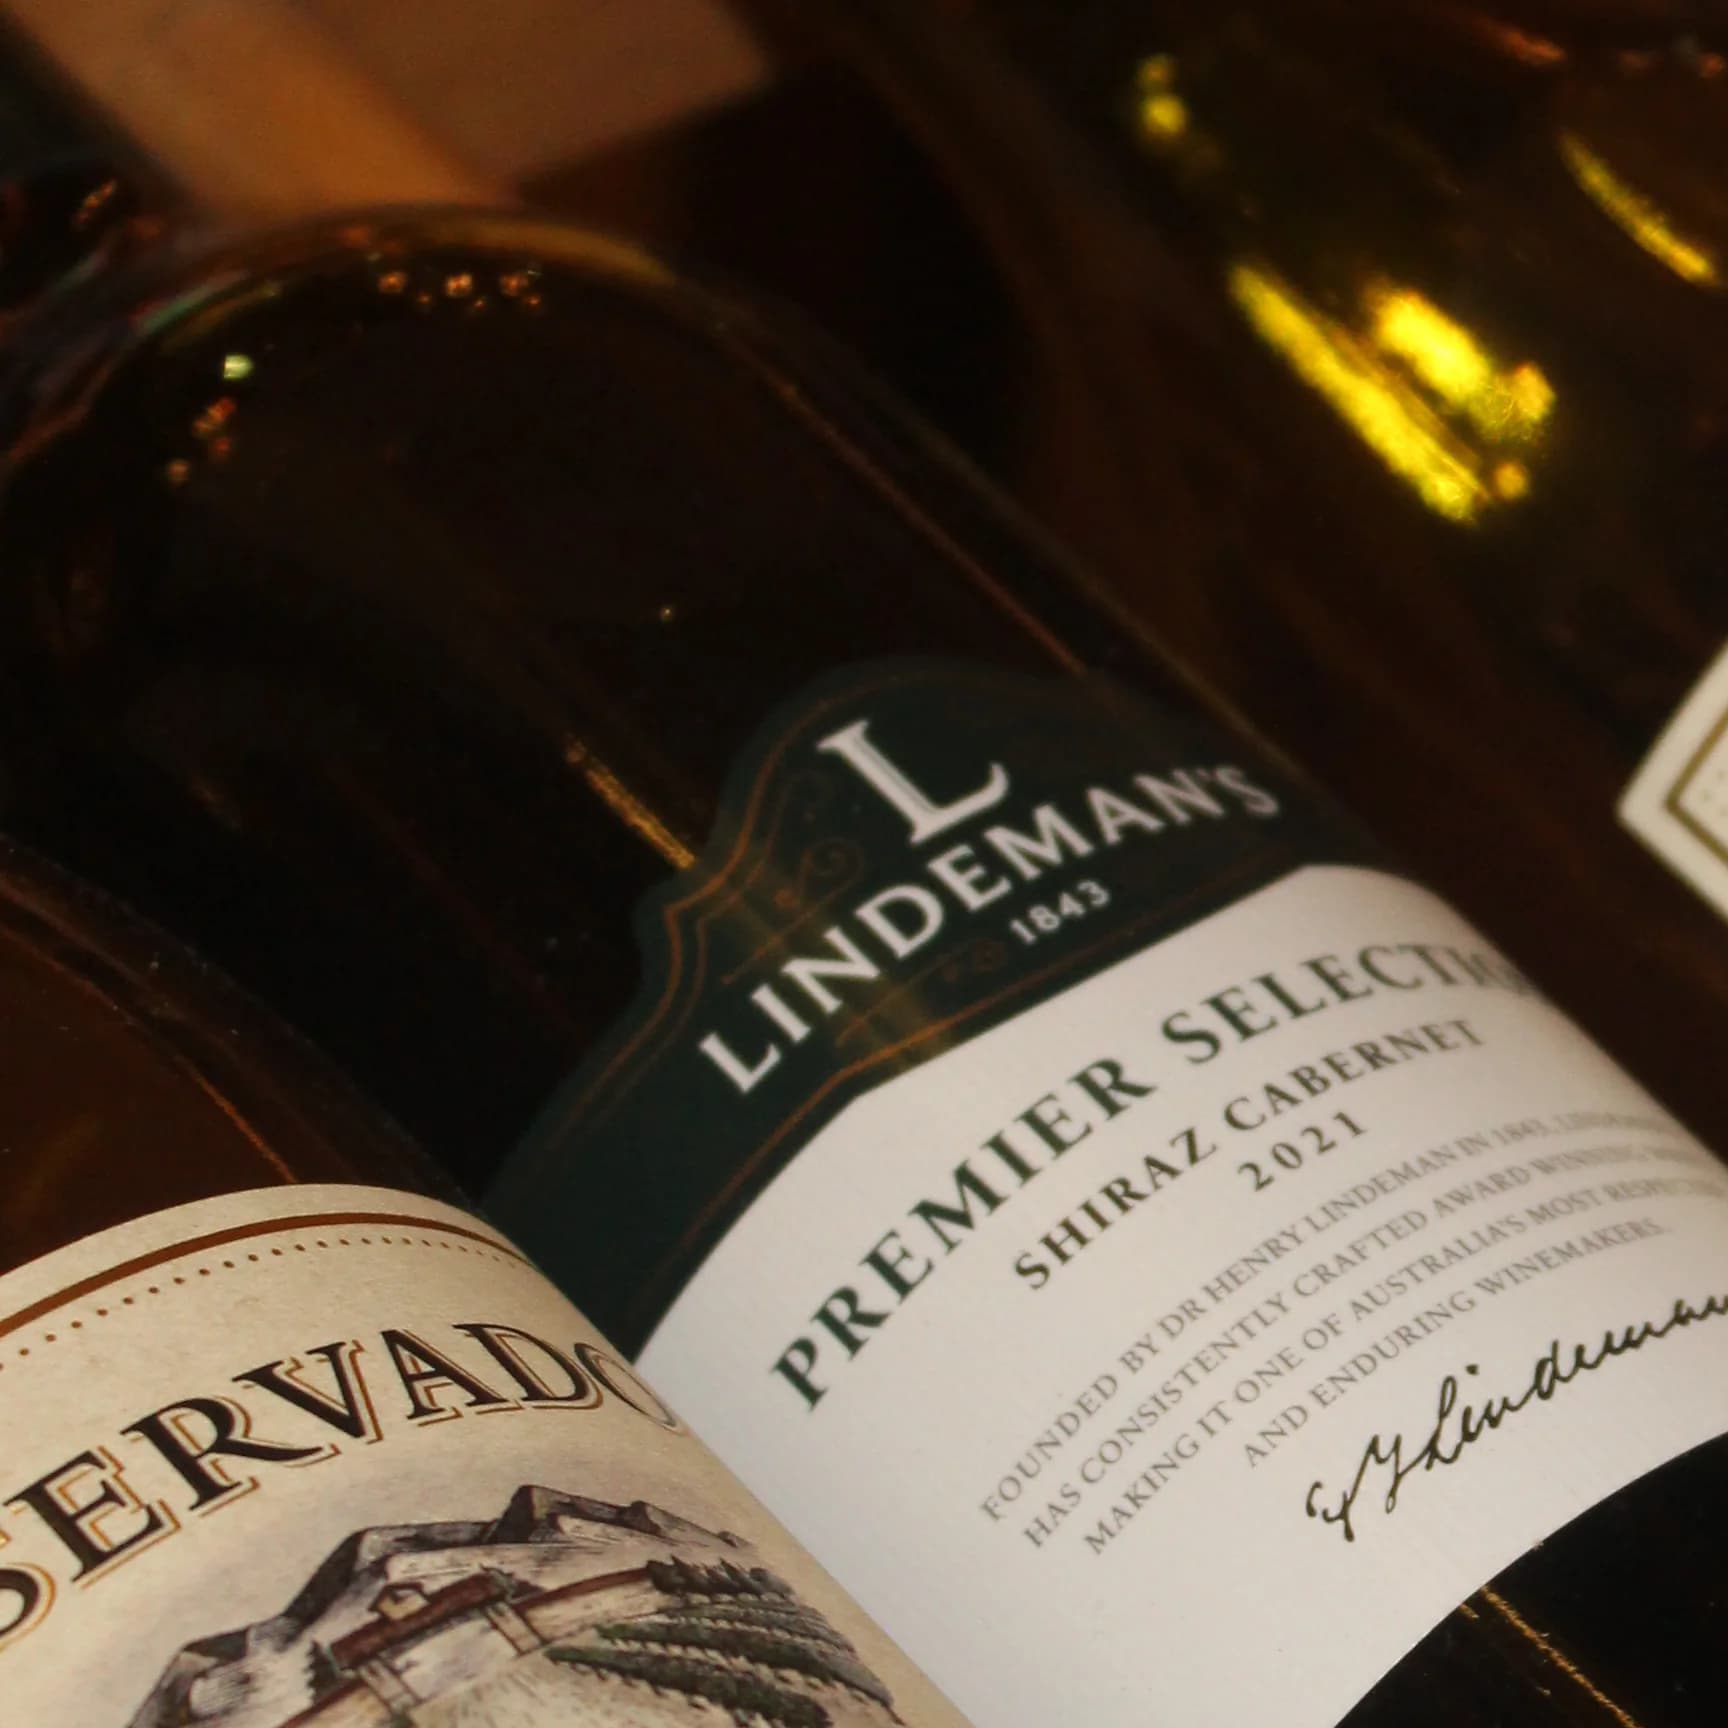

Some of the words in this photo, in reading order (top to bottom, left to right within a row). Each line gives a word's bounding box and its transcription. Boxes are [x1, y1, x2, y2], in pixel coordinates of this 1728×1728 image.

[816, 719, 1009, 845] L
[1009, 879, 1111, 946] 1843
[767, 1057, 1159, 1413] PREMIER
[1160, 942, 1538, 1065] SELECTI
[1013, 1126, 1219, 1291] SHIRAZ
[1223, 1019, 1486, 1133] CABERNET
[1237, 1110, 1368, 1193] 2021
[979, 1372, 1120, 1523] FOUNDED
[1117, 1332, 1161, 1374] BY
[1157, 1296, 1209, 1341] DR
[1201, 1223, 1305, 1305] HENRY
[1303, 1144, 1457, 1233] LINDEMAN
[1453, 1131, 1493, 1157] IN
[1022, 1482, 1082, 1549] HAS
[1080, 1292, 1291, 1485] CONSISTENTLY
[1291, 1208, 1428, 1298] CRAFTED
[1431, 1164, 1532, 1219] AWARD
[1083, 1432, 1201, 1556] MAKING
[1195, 1400, 1236, 1439] IT
[1233, 1346, 1305, 1405] ONE
[1302, 1312, 1345, 1352] OF
[1349, 1213, 1528, 1322] AUSTRALIA'S
[1524, 1187, 1605, 1225] MOST
[1243, 1403, 1309, 1468] AND
[1308, 1289, 1477, 1409] ENDURING
